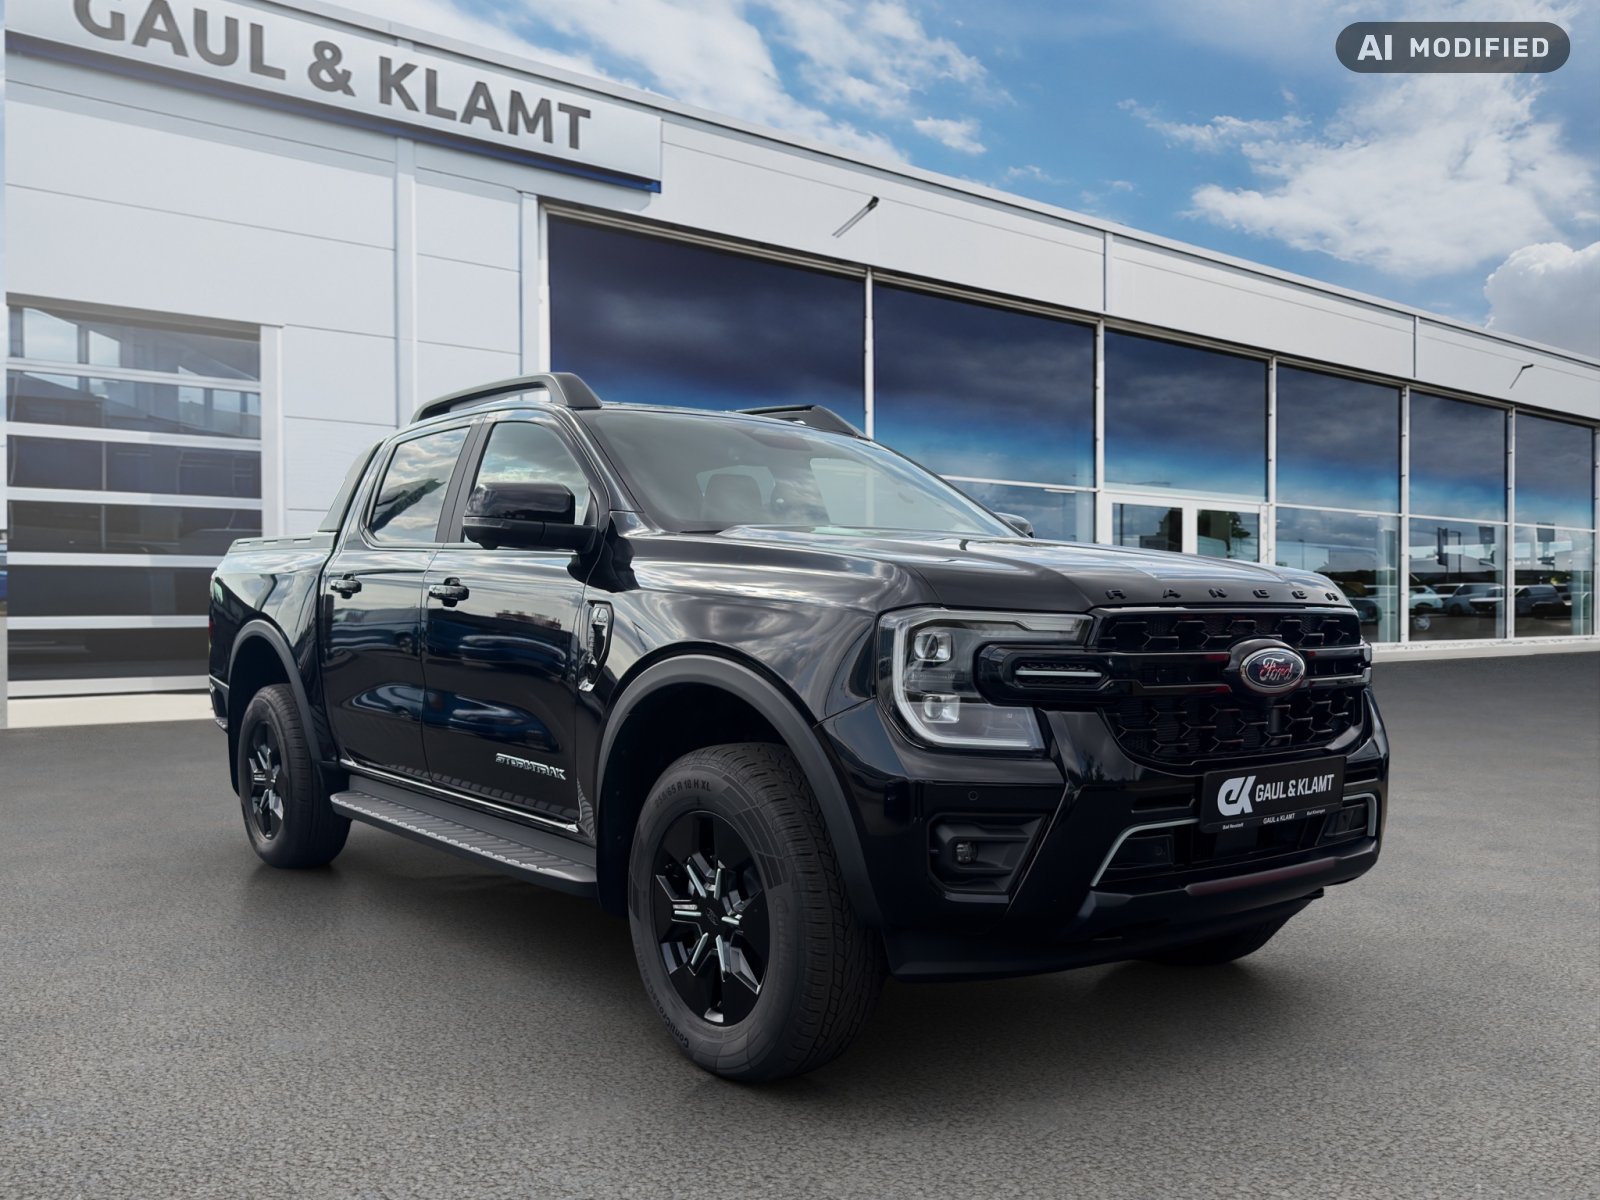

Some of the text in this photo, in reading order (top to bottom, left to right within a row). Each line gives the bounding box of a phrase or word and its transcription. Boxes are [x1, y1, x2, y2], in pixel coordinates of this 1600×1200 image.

[72, 0, 592, 150] GAUL & KLAMT
[1104, 587, 1340, 602] RANGER
[1258, 656, 1295, 682] Ford
[1256, 774, 1335, 802] GAUL & KLAMT
[1263, 816, 1276, 825] GAUL
[1280, 813, 1295, 822] KLAMT
